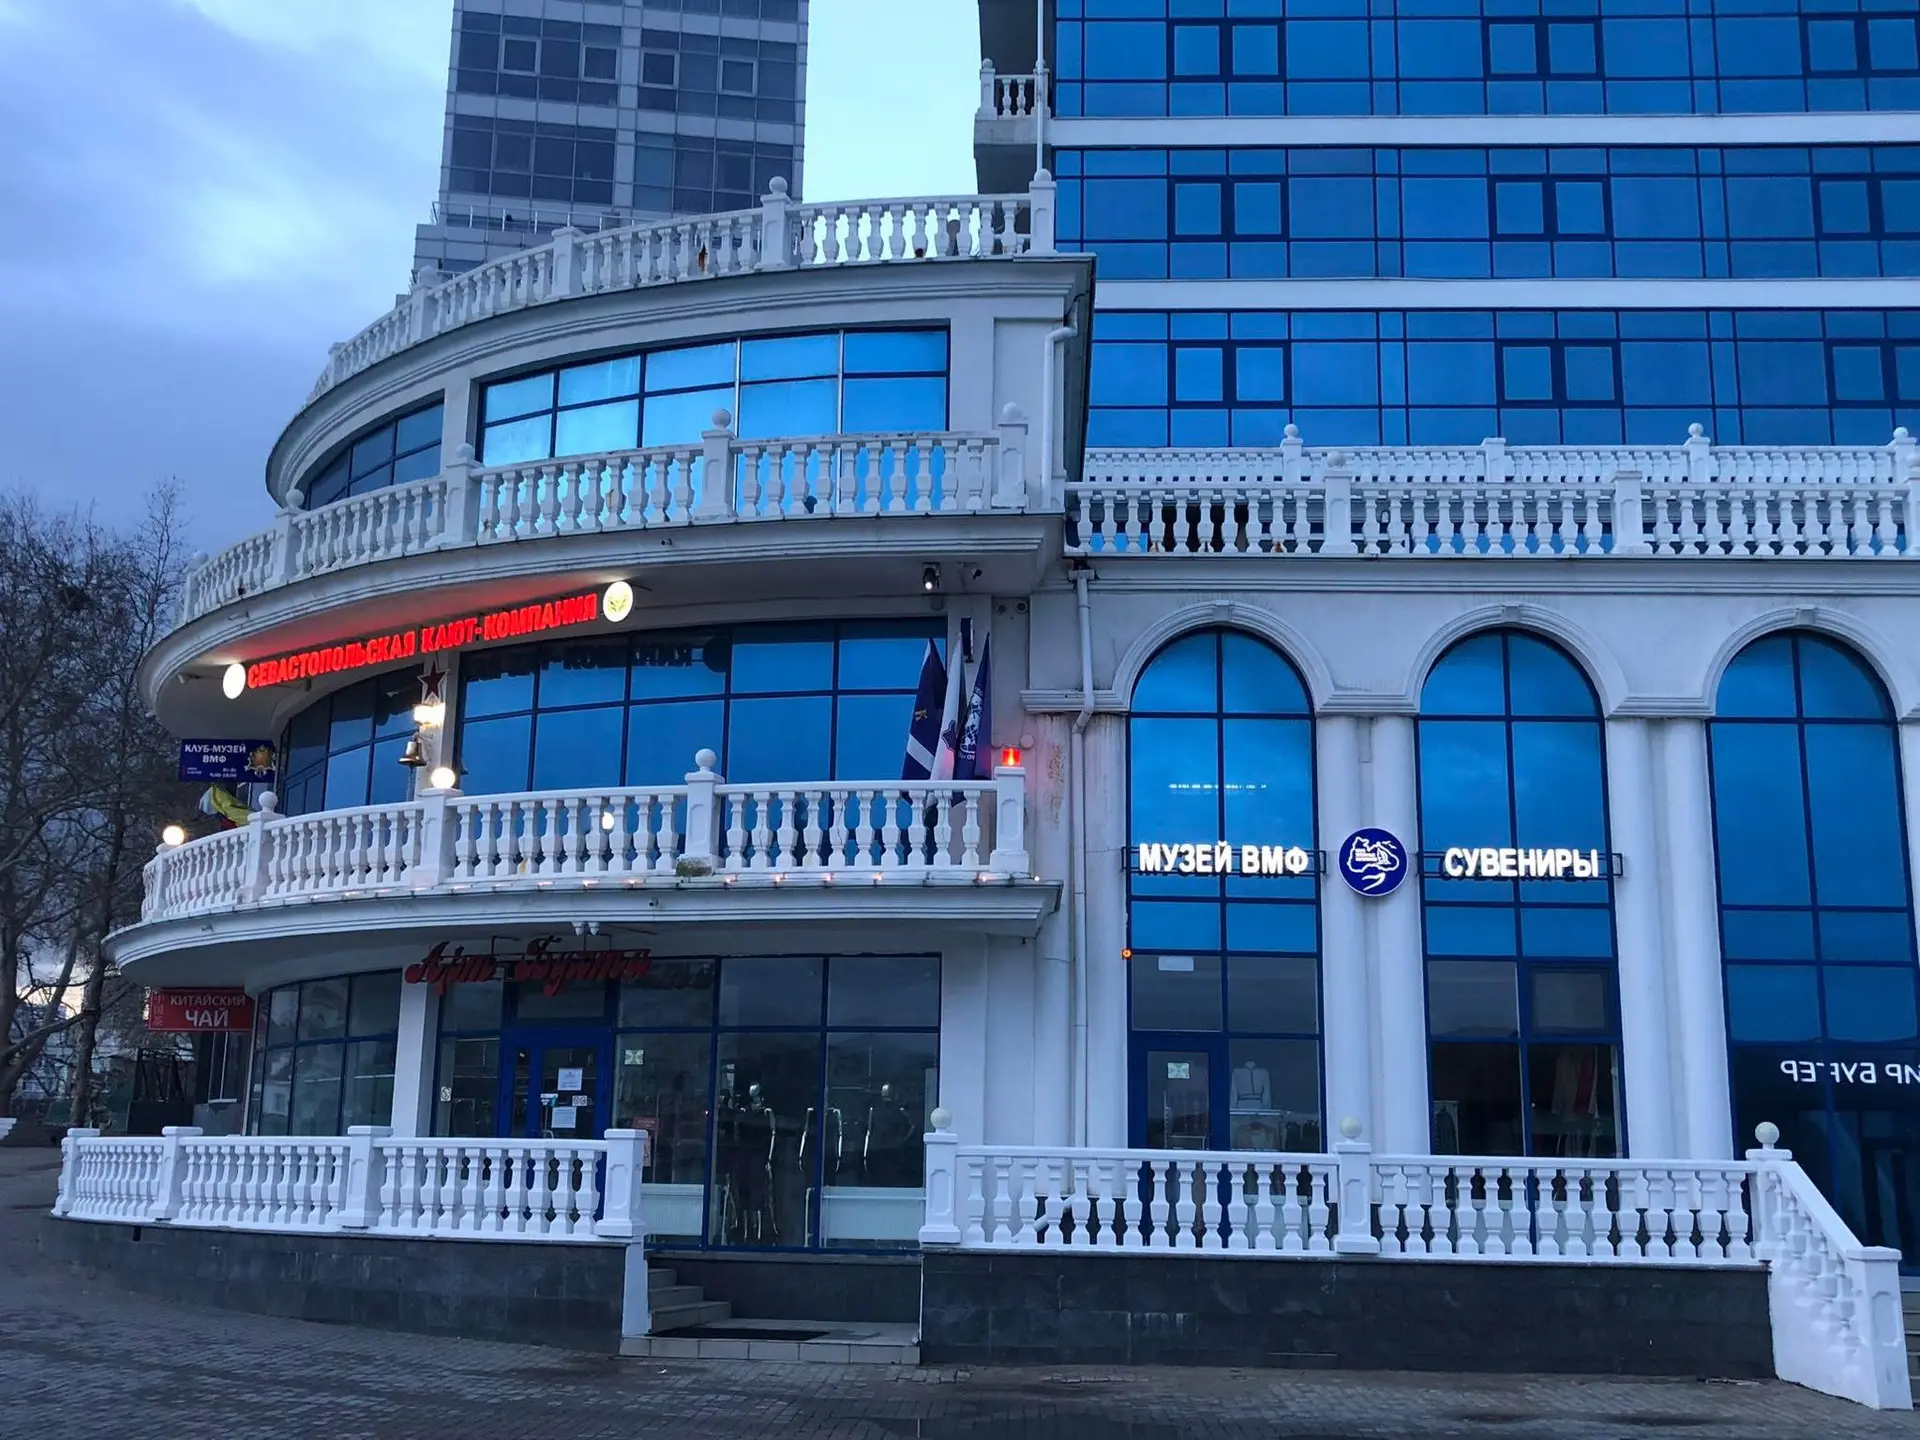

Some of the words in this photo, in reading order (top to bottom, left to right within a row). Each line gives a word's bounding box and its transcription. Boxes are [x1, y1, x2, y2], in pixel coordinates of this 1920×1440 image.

[247, 630, 415, 688] СЕВАСТОПОЛЬСКАЯ
[421, 594, 597, 653] КАЮТ-КОМПАНИЯ
[185, 743, 246, 753] КЛУБ-МУЗЕЙ
[202, 754, 227, 764] ВМФ
[1138, 841, 1232, 874] МУЗЕЙ
[1241, 844, 1310, 876] ВМФ
[1444, 847, 1600, 879] СУВЕНИРЫ
[170, 994, 245, 1006] КИТАЙСКИЙ
[185, 1007, 229, 1028] ЧАЙ
